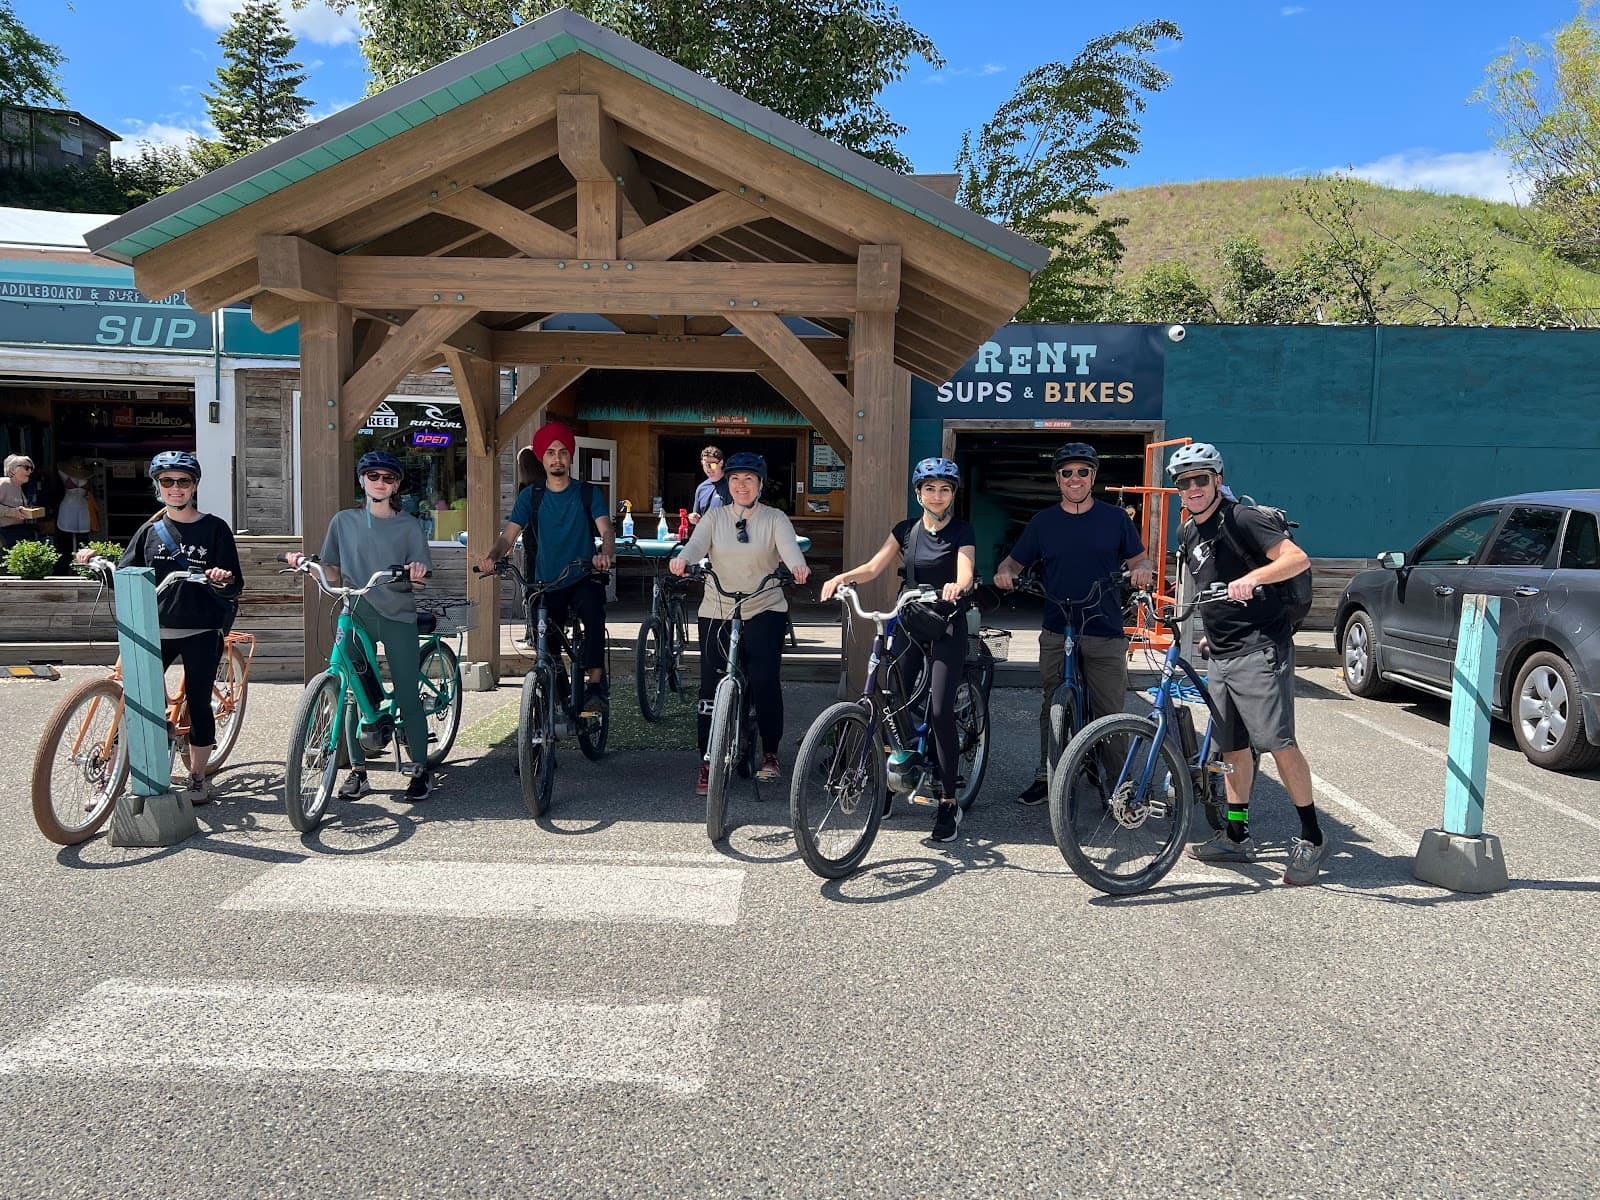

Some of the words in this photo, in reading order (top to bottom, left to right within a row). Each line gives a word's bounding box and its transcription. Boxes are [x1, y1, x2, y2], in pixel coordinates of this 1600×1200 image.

[0, 283, 82, 299] ADDLEBOARD
[90, 289, 99, 300] &
[109, 290, 141, 302] SURF
[96, 315, 196, 347] SUP
[975, 341, 1097, 375] RENT
[937, 381, 1012, 403] SUPS
[1023, 387, 1034, 399] &
[1044, 381, 1134, 403] BIKES
[368, 417, 397, 426] REEF
[431, 420, 462, 429] CURL
[416, 435, 449, 444] OPEN
